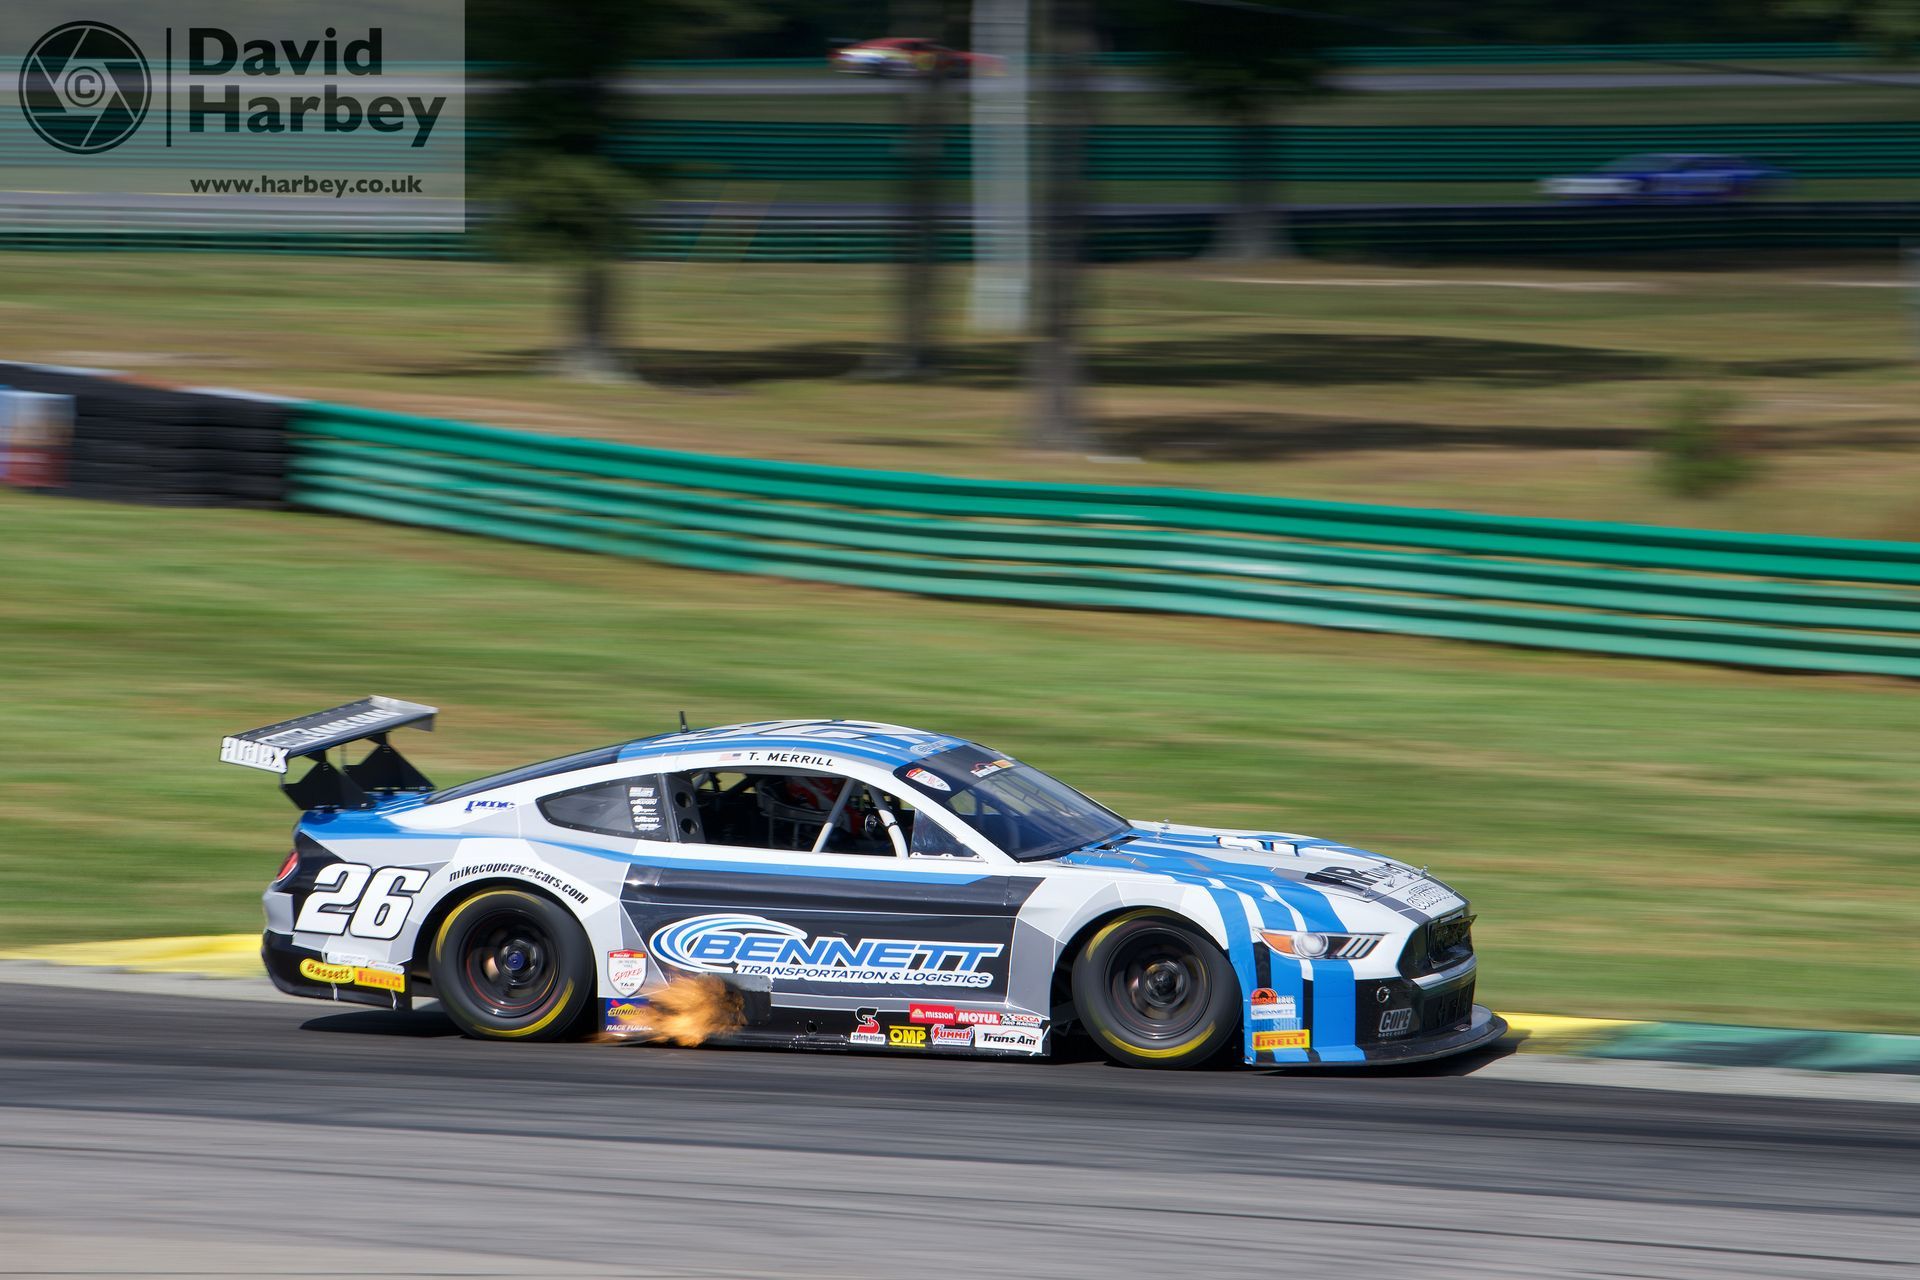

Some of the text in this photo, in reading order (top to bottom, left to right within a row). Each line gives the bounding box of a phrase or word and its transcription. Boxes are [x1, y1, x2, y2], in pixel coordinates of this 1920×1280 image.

[749, 752, 834, 767] T. MERRILL
[294, 862, 430, 940] 26
[686, 932, 1003, 972] BENNETT
[741, 965, 990, 985] TRANSPORTATION & LOGISTICS
[957, 1012, 999, 1024] MOTUL
[1014, 1015, 1039, 1023] SCCA
[889, 1029, 927, 1044] OMP
[983, 1033, 1036, 1046] Trans Am
[1255, 1032, 1306, 1047] PIRELLI
